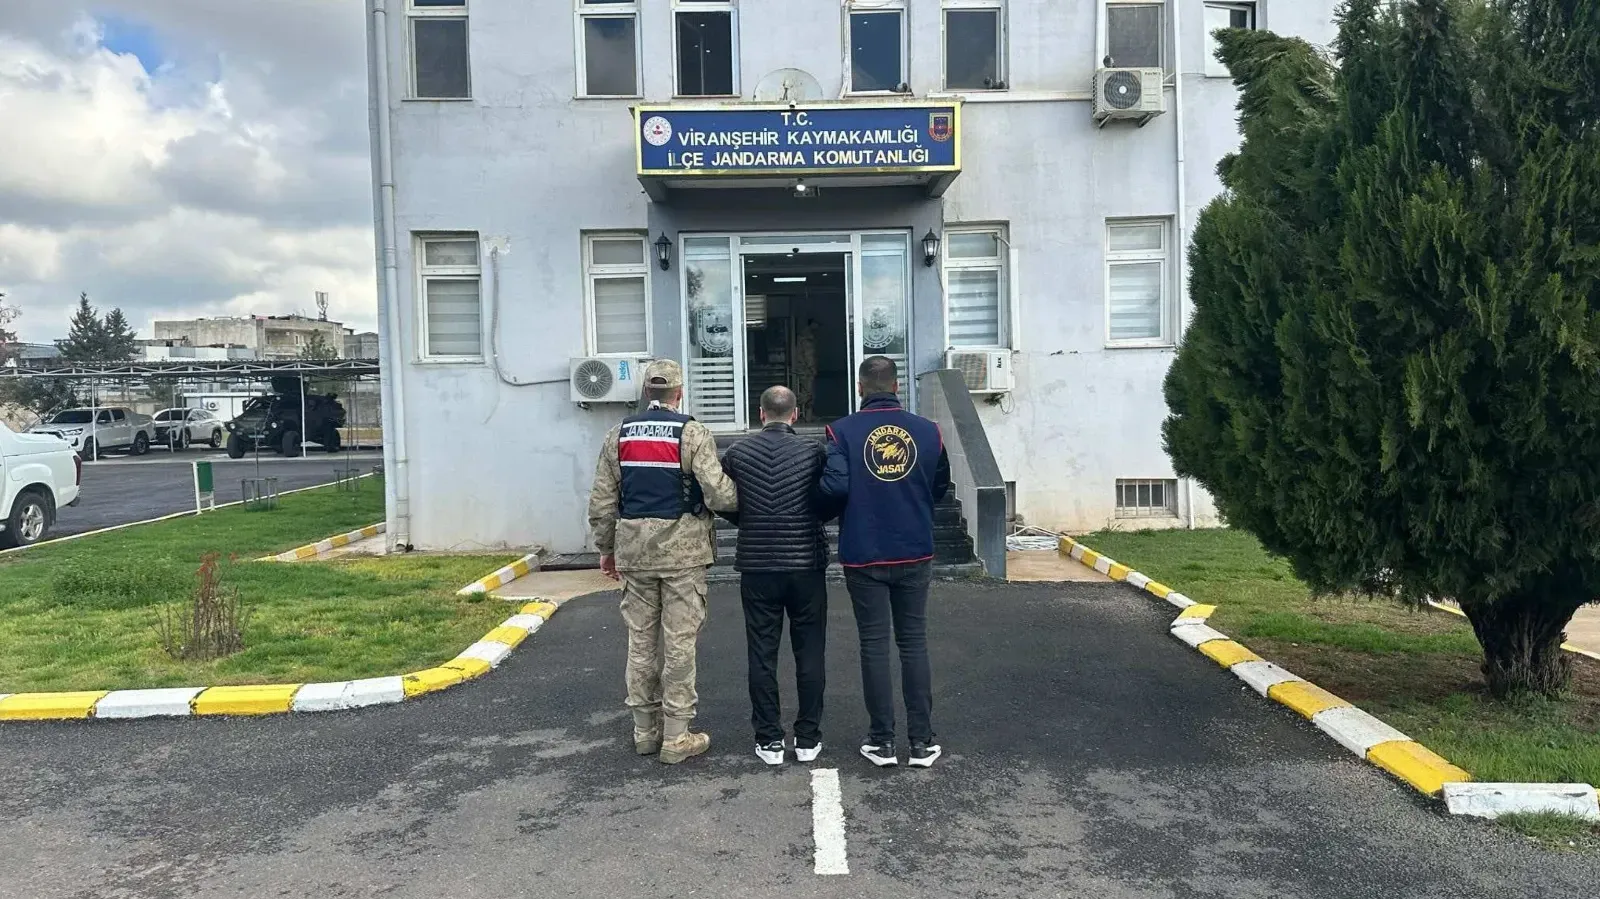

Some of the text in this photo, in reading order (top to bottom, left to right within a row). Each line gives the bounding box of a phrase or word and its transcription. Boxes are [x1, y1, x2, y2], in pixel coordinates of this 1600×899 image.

[780, 111, 813, 126] T.C.
[677, 124, 918, 150] VİRANŞEHİR KAYMAKAMLIĞI
[667, 144, 929, 169] İLÇE JANDARMA KOMUTANLIĞI
[626, 425, 674, 438] JANDARMA
[868, 427, 911, 446] JANDARMA
[877, 464, 905, 474] JASAT
